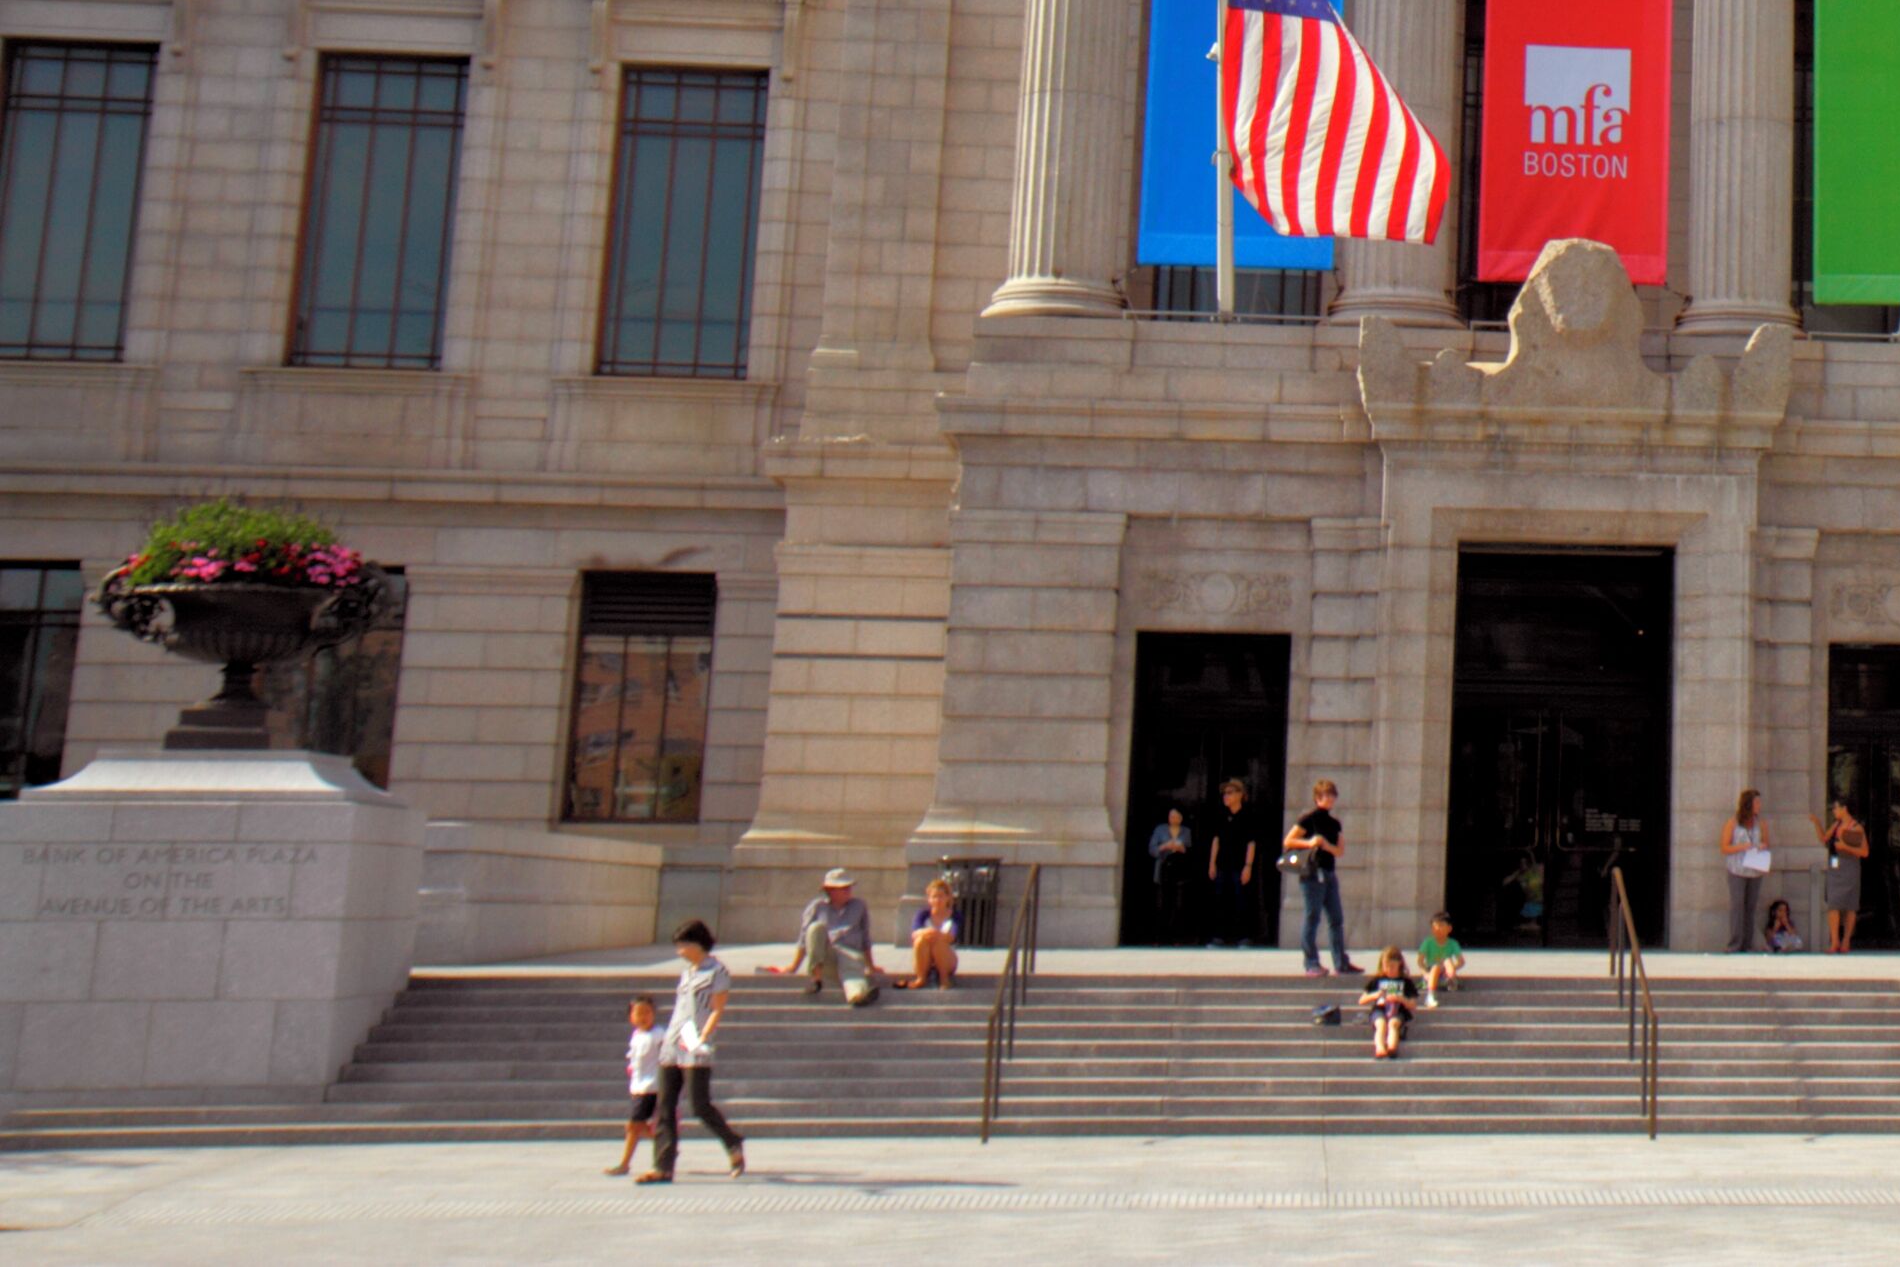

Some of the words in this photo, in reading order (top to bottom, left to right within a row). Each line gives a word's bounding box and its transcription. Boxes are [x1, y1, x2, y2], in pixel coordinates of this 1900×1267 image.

[1525, 82, 1630, 146] mfa
[1523, 151, 1628, 179] BOSTON
[22, 846, 86, 865] BANK
[95, 847, 128, 864] OF
[136, 847, 236, 865] AMERICA
[246, 847, 319, 865] PLAZA
[122, 871, 161, 890] ON
[170, 871, 214, 889] THE
[39, 896, 132, 915] AVENUE
[139, 896, 168, 914] OF
[180, 896, 221, 914] THE
[230, 896, 287, 914] ARTS
